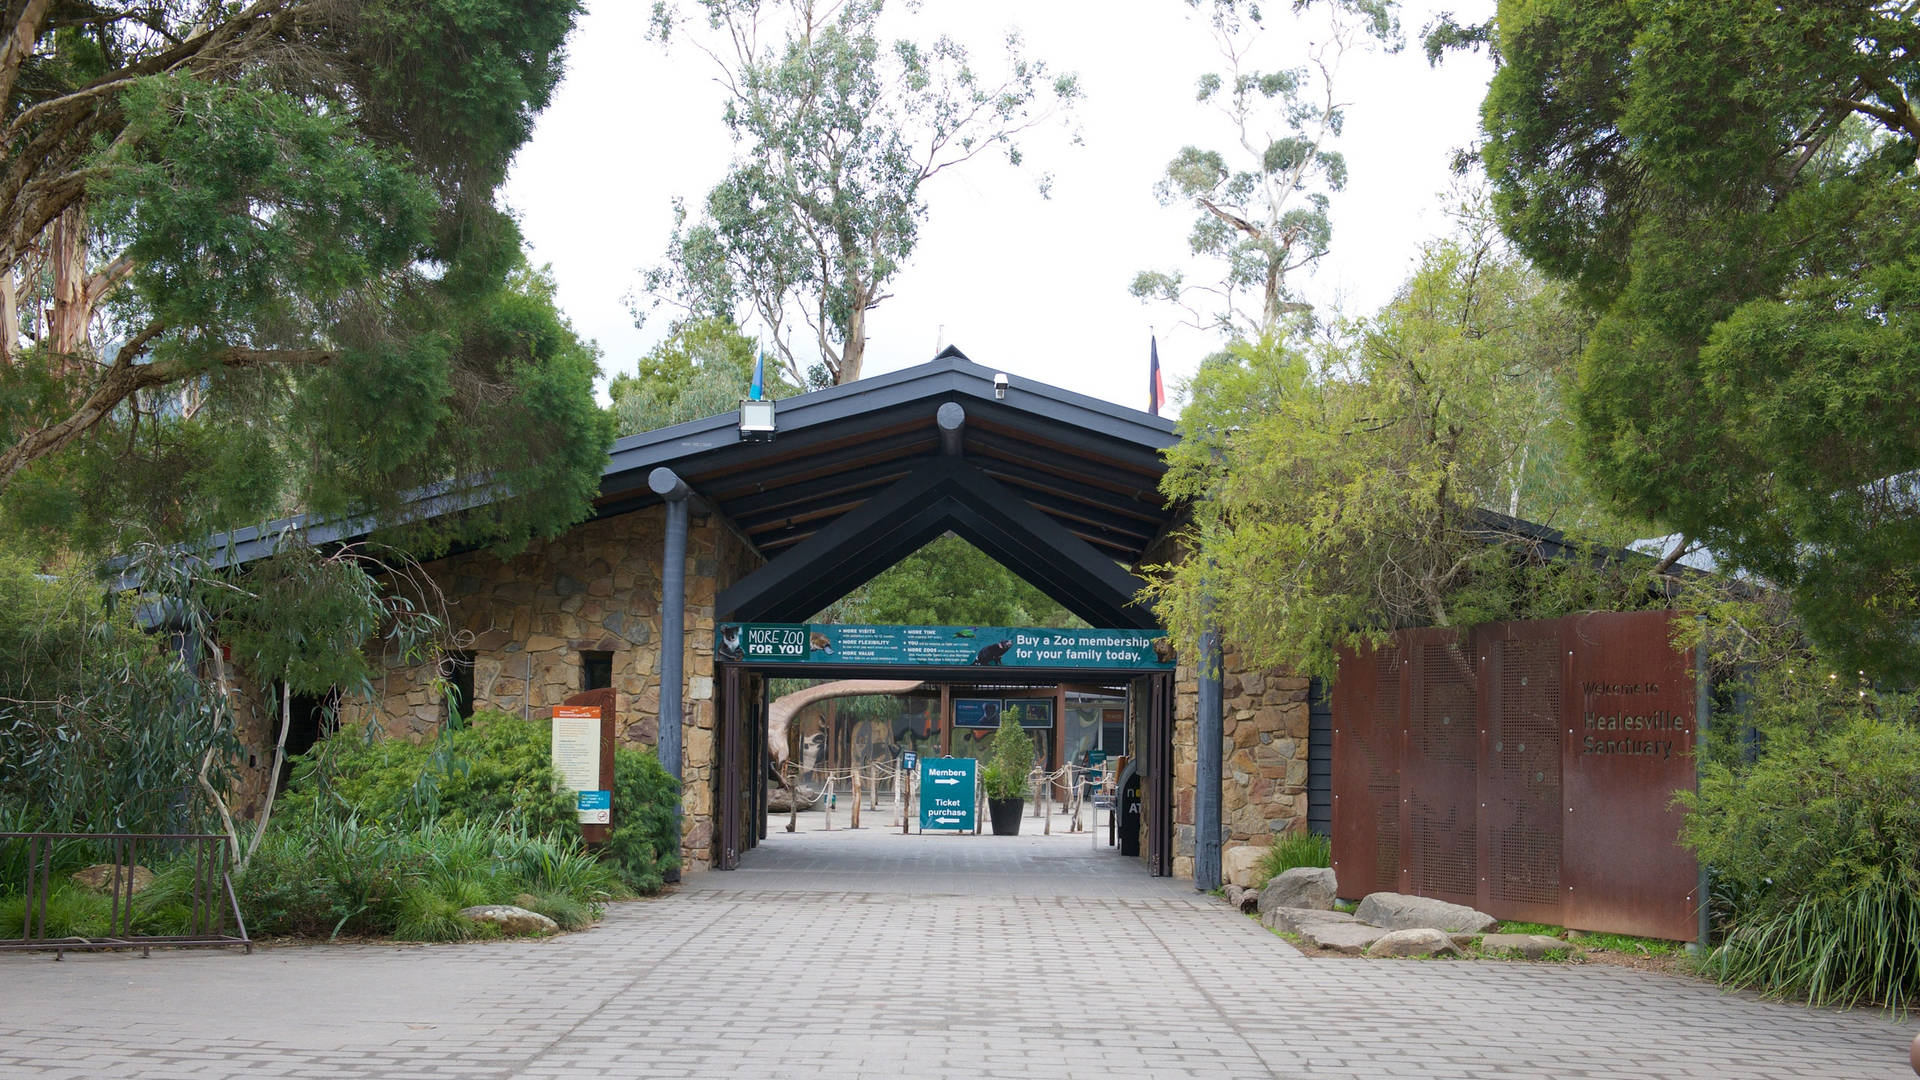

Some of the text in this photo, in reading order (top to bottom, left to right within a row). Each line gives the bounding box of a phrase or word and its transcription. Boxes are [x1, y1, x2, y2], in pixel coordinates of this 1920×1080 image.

[748, 630, 805, 645] MORE ZOO
[1016, 635, 1150, 649] Buy a Zoo membership
[749, 644, 804, 654] FOR YOU
[1016, 648, 1141, 662] for your family today.
[1583, 681, 1659, 695] Welcome to
[1584, 711, 1684, 731] Healesville
[1583, 735, 1672, 761] Sanctuary
[928, 768, 967, 777] Members
[935, 798, 960, 807] Ticket
[928, 809, 967, 817] purchase
